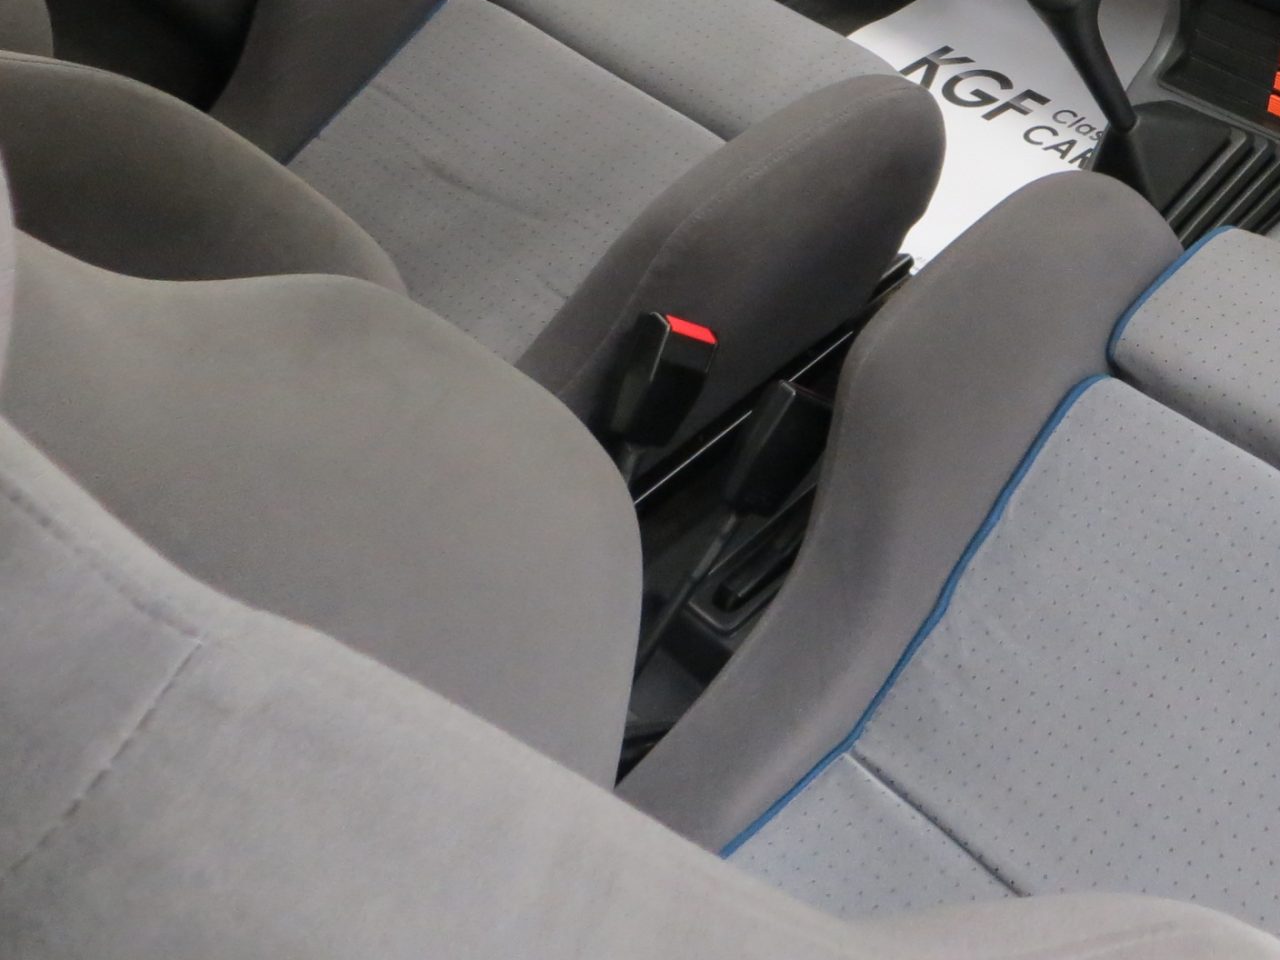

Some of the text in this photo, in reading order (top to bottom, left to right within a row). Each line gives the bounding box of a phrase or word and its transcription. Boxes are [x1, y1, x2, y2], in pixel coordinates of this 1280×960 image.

[899, 45, 1104, 142] KGF Clas
[1023, 125, 1094, 169] CAR
